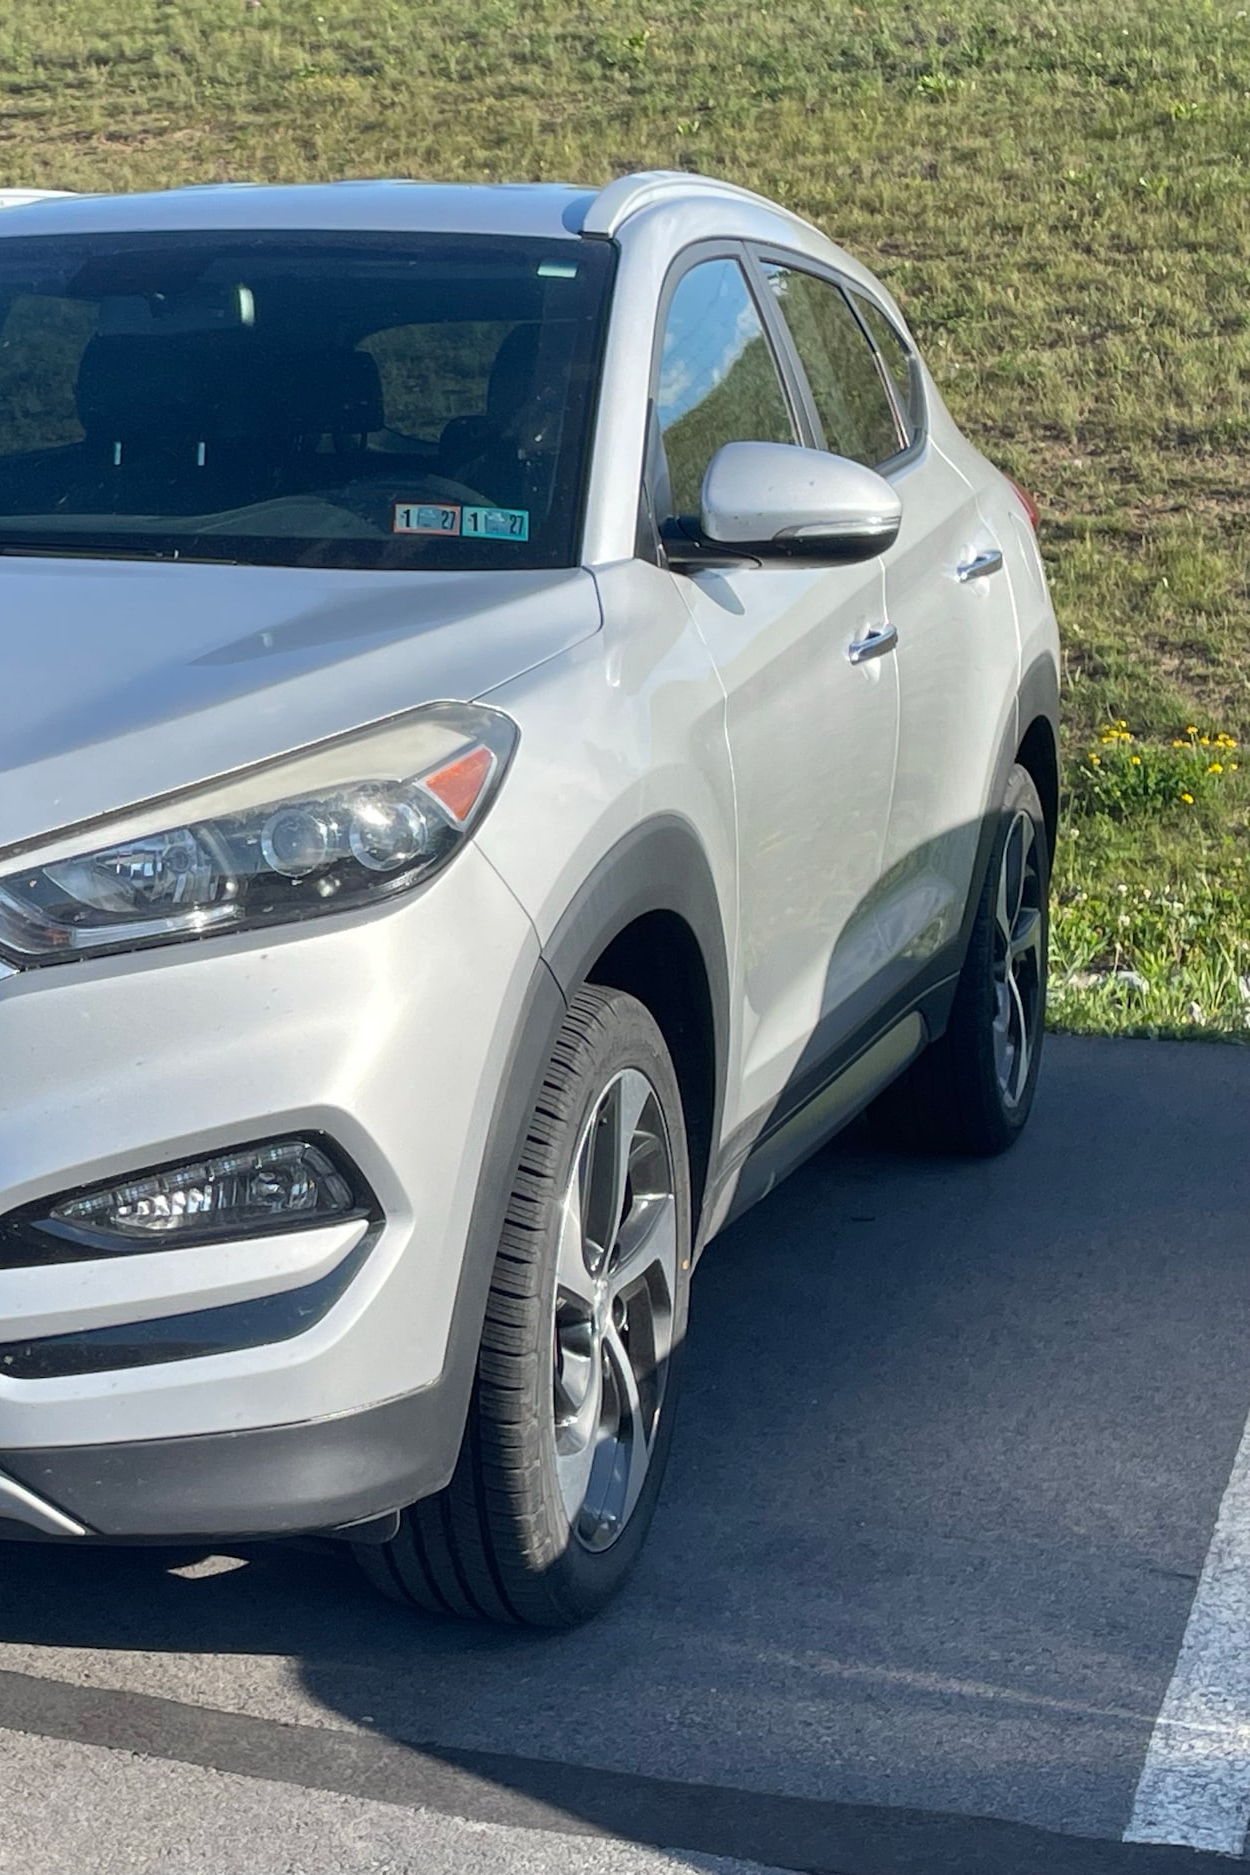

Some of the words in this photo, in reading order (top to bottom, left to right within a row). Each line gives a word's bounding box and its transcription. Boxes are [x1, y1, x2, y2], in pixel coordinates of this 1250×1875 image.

[403, 509, 411, 528] 1
[441, 510, 456, 530] 27
[470, 512, 478, 531] 1
[509, 514, 524, 535] 27
